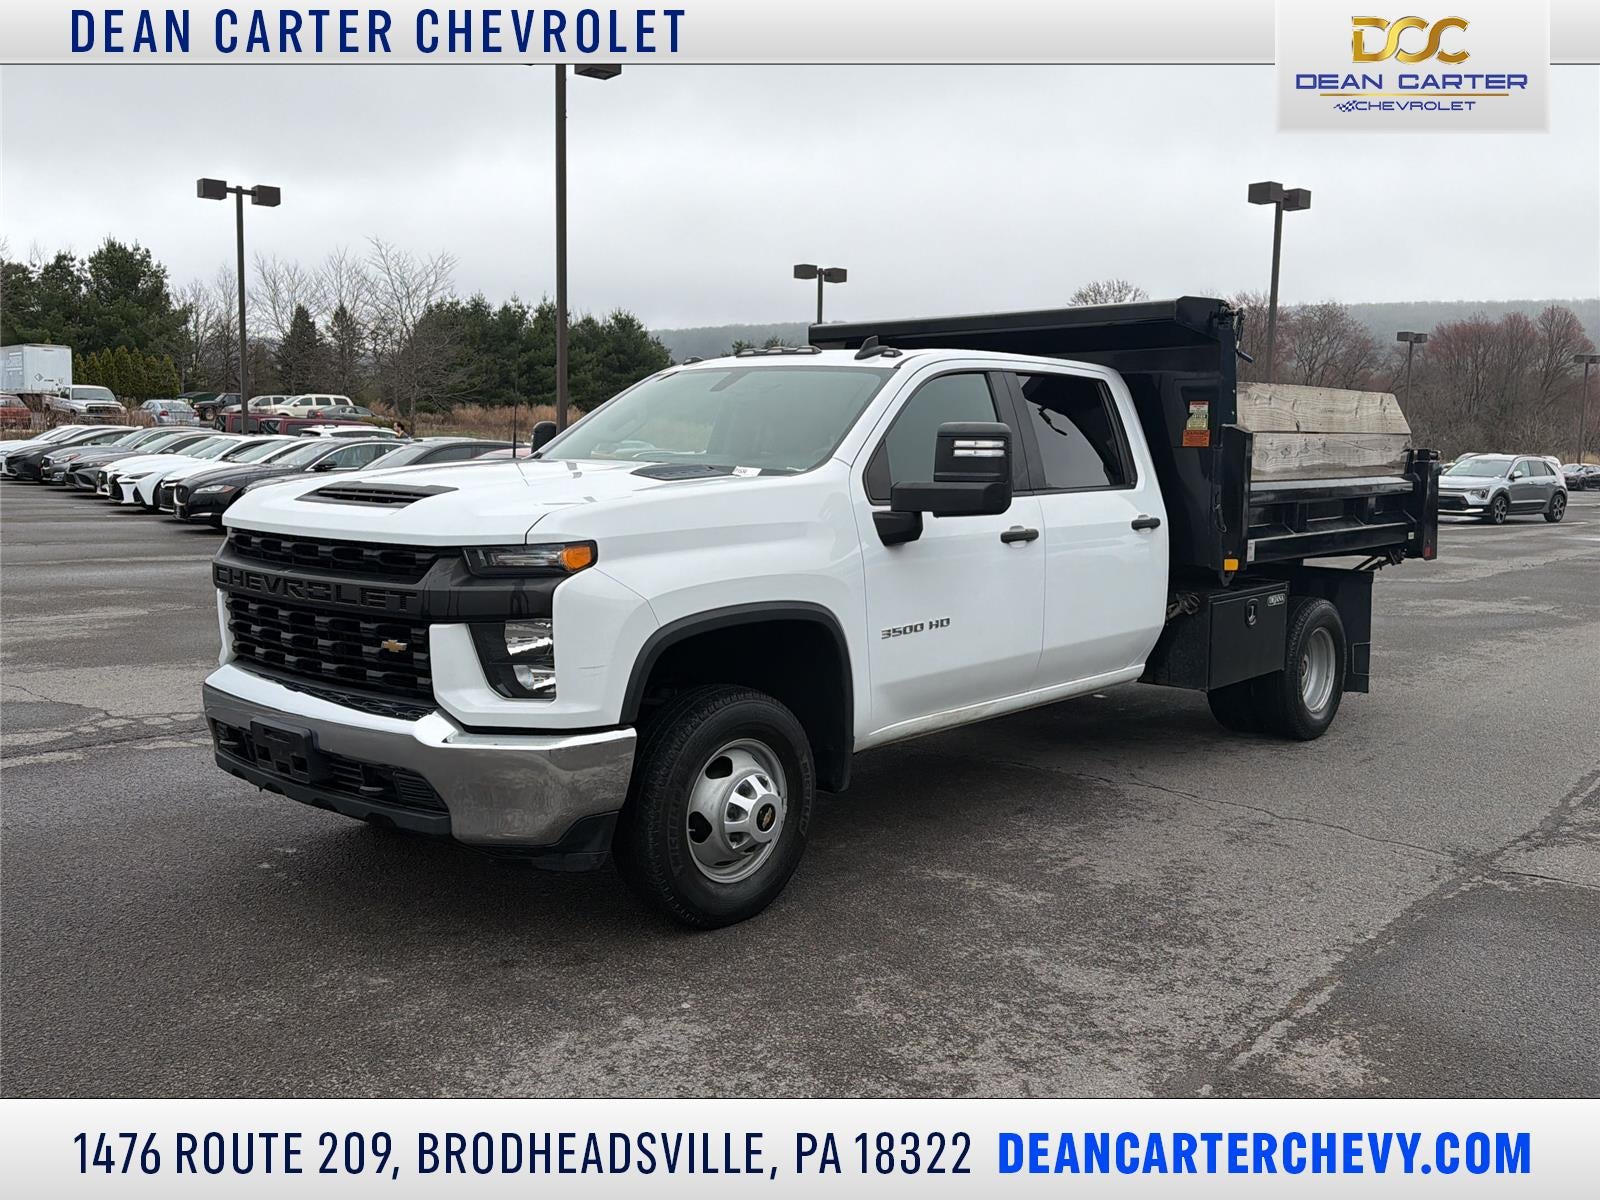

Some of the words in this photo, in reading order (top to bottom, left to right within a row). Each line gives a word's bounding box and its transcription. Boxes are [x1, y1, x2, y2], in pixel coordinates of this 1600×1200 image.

[215, 564, 418, 612] CHEVROLET
[881, 622, 925, 640] 3500
[928, 617, 951, 631] HD
